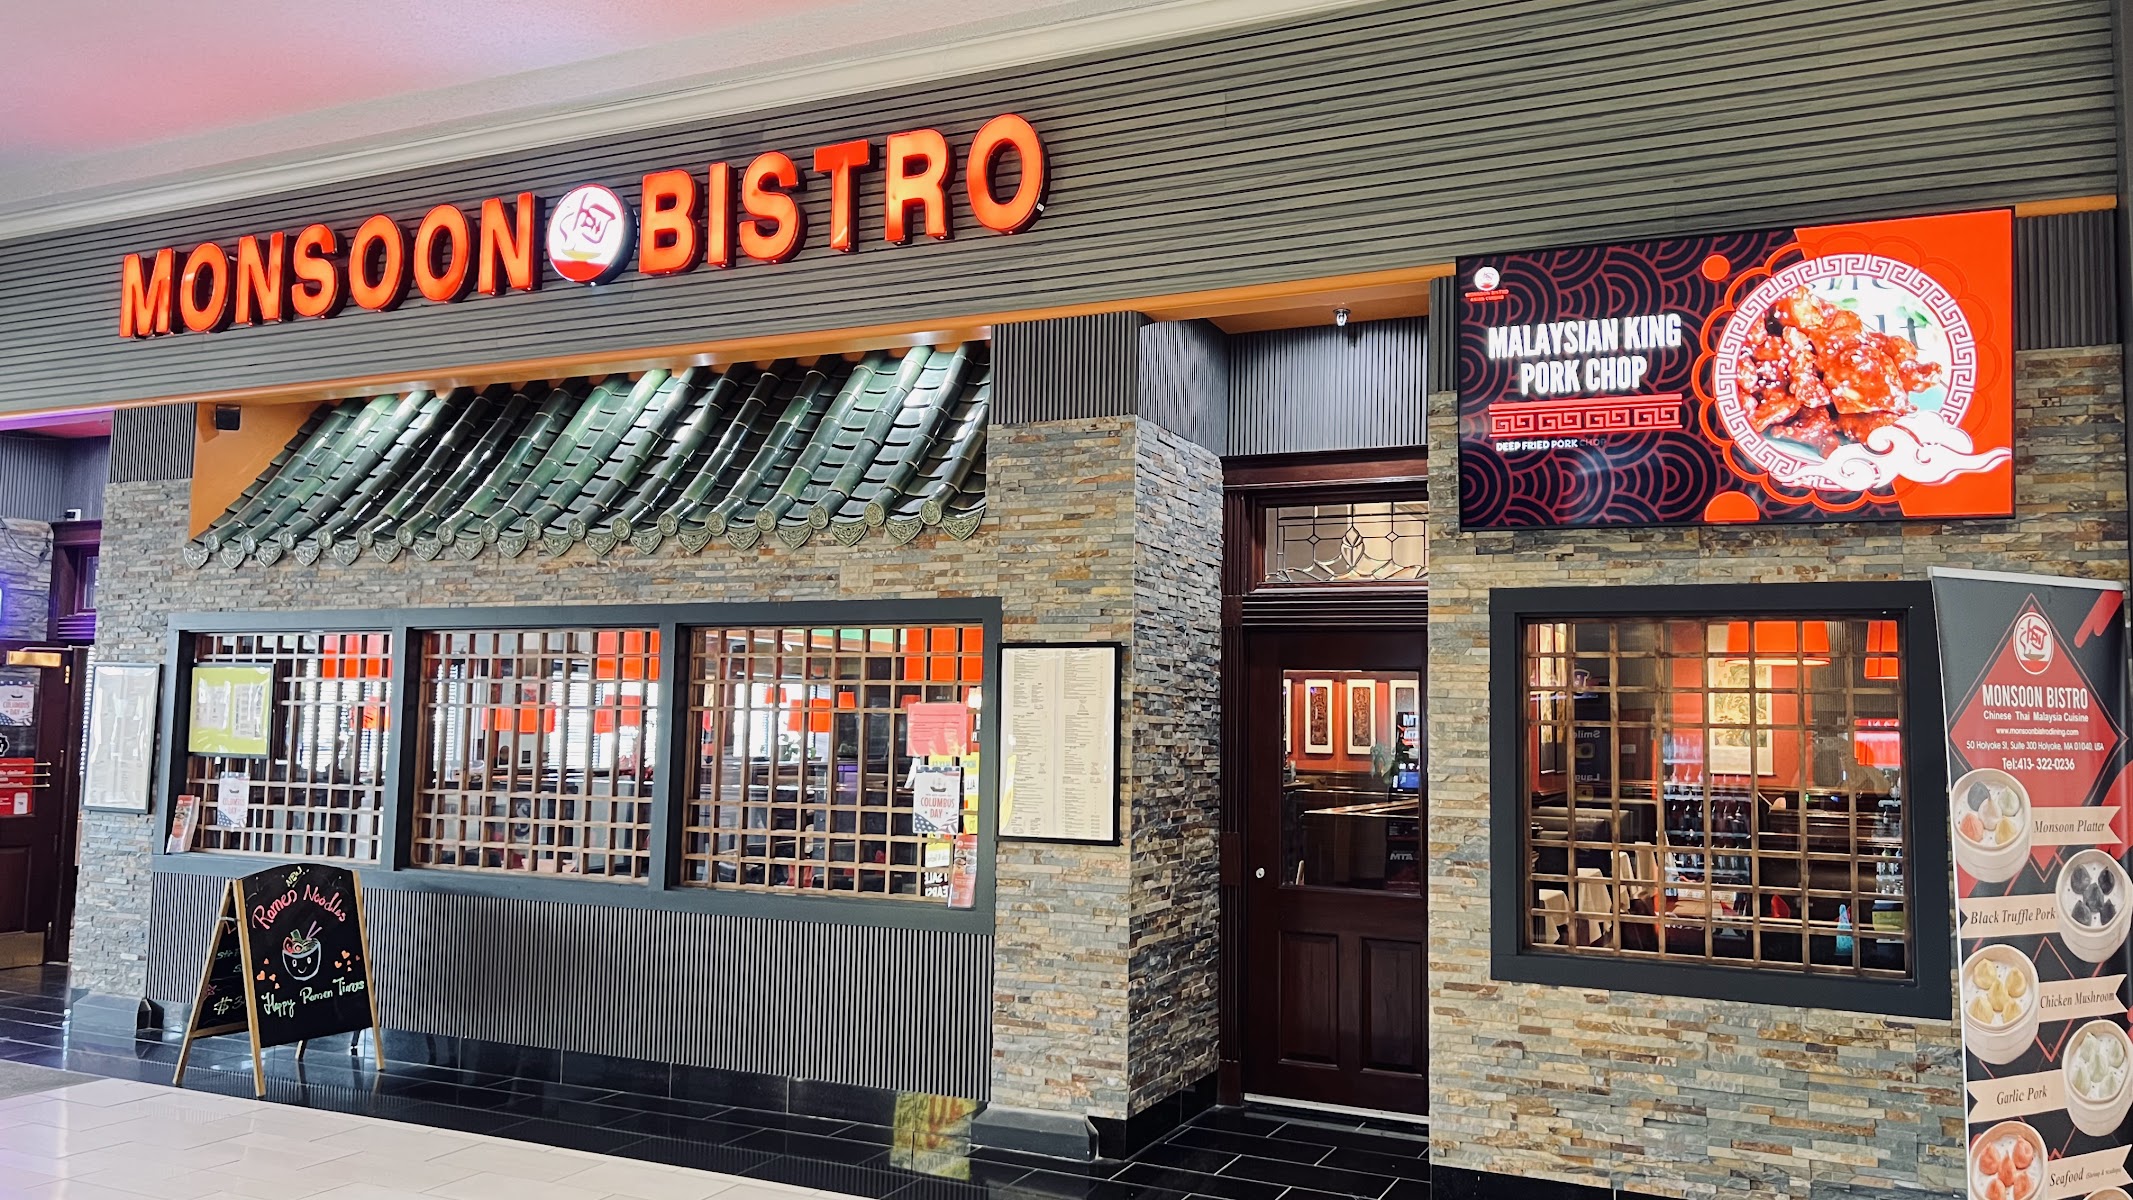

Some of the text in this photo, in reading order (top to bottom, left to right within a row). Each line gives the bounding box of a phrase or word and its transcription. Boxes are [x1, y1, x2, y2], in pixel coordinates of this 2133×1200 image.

[118, 113, 1048, 338] MONSOON BISTRO
[1488, 313, 1682, 359] MALAYSIAN KING
[1521, 355, 1647, 395] PORK CHOP
[1496, 441, 1521, 451] DEEP
[1522, 440, 1550, 451] FRIED
[1551, 439, 1578, 449] PORK
[1982, 684, 2088, 709] MONSOON BISTRO
[1983, 710, 2089, 723] Chinese Thai Malaysia Cuisine
[1996, 727, 2079, 737] www.monsoonbistrodining.com
[1966, 740, 1975, 749] 50
[1976, 740, 2001, 751] Holyoke
[2010, 741, 2025, 750] Suite
[2026, 741, 2037, 750] 300
[2063, 742, 2073, 750] MA
[2094, 742, 2105, 751] USA
[2036, 757, 2075, 770] 322-0236
[920, 797, 955, 808] COLUMBUS
[929, 808, 943, 818] DAY
[2033, 819, 2105, 833] Monsoon Platter
[251, 884, 346, 930] Ramen Noodles
[1970, 907, 2056, 925] Black Truffle Pork
[261, 976, 365, 1018] Happy Ramen Times
[2040, 990, 2115, 1009] Chicken Mushroom
[1997, 1085, 2047, 1105] Garlic Pork
[2049, 1167, 2084, 1188] Seafood
